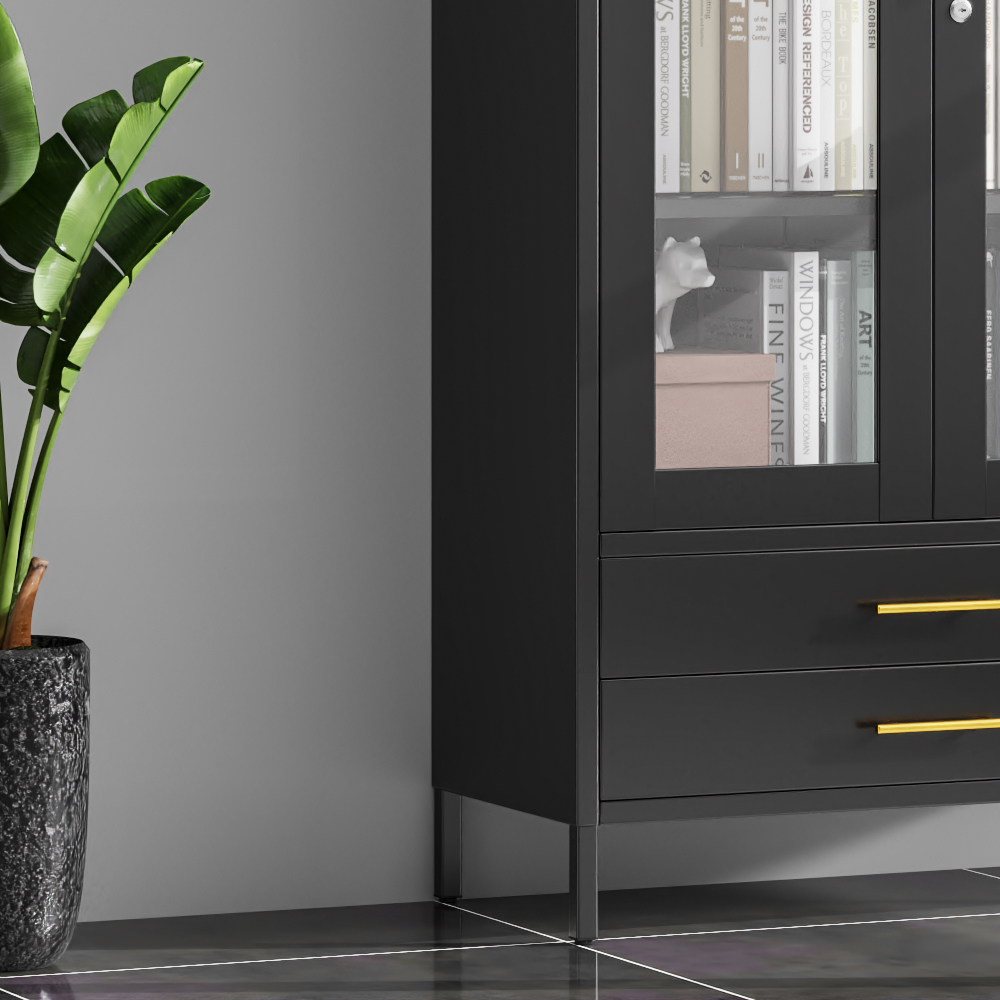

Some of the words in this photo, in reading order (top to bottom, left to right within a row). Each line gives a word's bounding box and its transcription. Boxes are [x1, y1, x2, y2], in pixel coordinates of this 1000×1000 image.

[778, 11, 787, 25] THE
[778, 28, 787, 44] BIKE
[681, 24, 690, 57] LLOYD
[727, 33, 747, 43] Century
[751, 33, 770, 43] Century
[778, 46, 787, 65] BOOK
[821, 10, 831, 87] BORDEAUX
[660, 35, 670, 84] BERGDORF
[681, 58, 690, 99] WRIGHT
[802, 42, 812, 134] REFERENCED
[660, 86, 670, 137] GOODMAN
[799, 260, 814, 361] WINDOWS
[859, 310, 873, 348] ART
